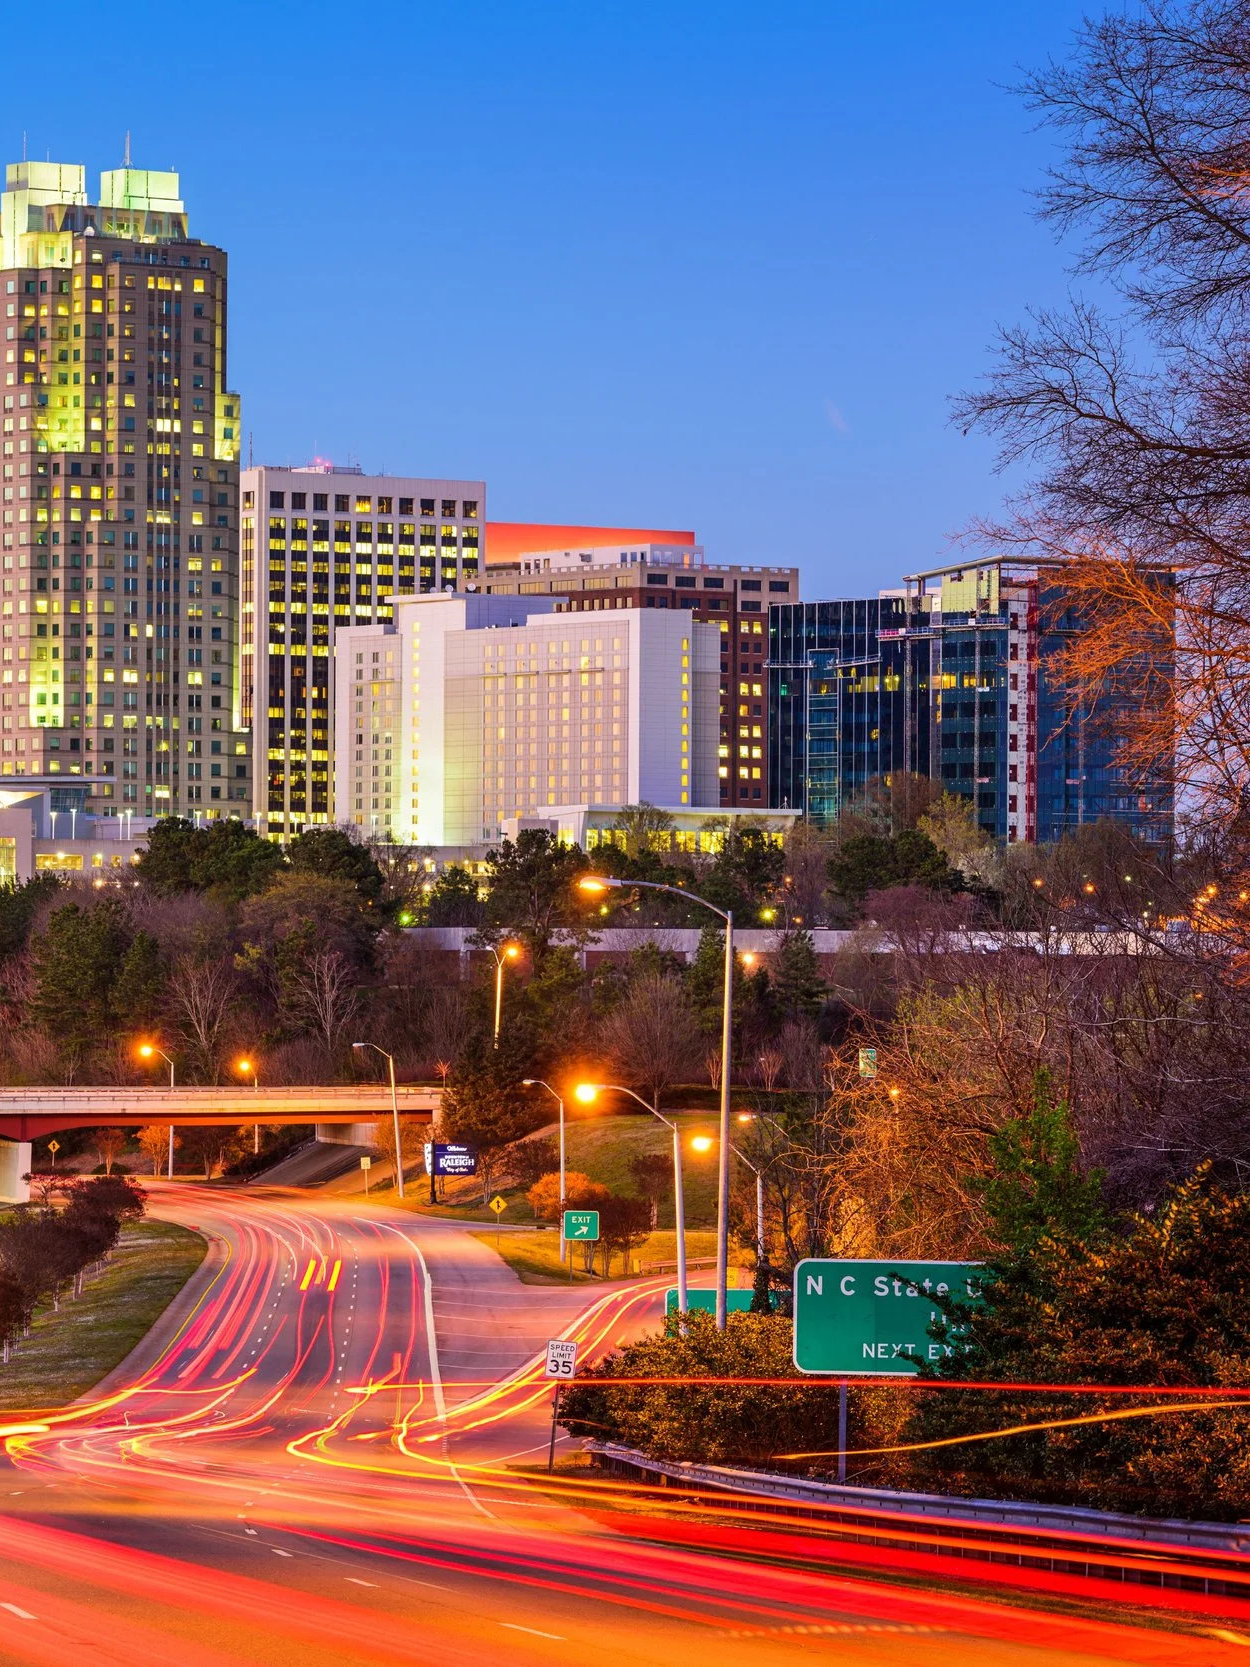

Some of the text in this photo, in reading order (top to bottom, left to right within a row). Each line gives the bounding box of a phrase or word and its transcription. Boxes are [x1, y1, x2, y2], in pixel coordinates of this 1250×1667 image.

[440, 1158, 474, 1167] RALEIGH
[571, 1216, 591, 1224] EXIT
[806, 1275, 823, 1296] N
[840, 1275, 856, 1296] C
[873, 1276, 949, 1297] State
[550, 1343, 575, 1352] SPEED
[862, 1343, 973, 1360] NEXT EXT
[549, 1359, 573, 1374] 35
